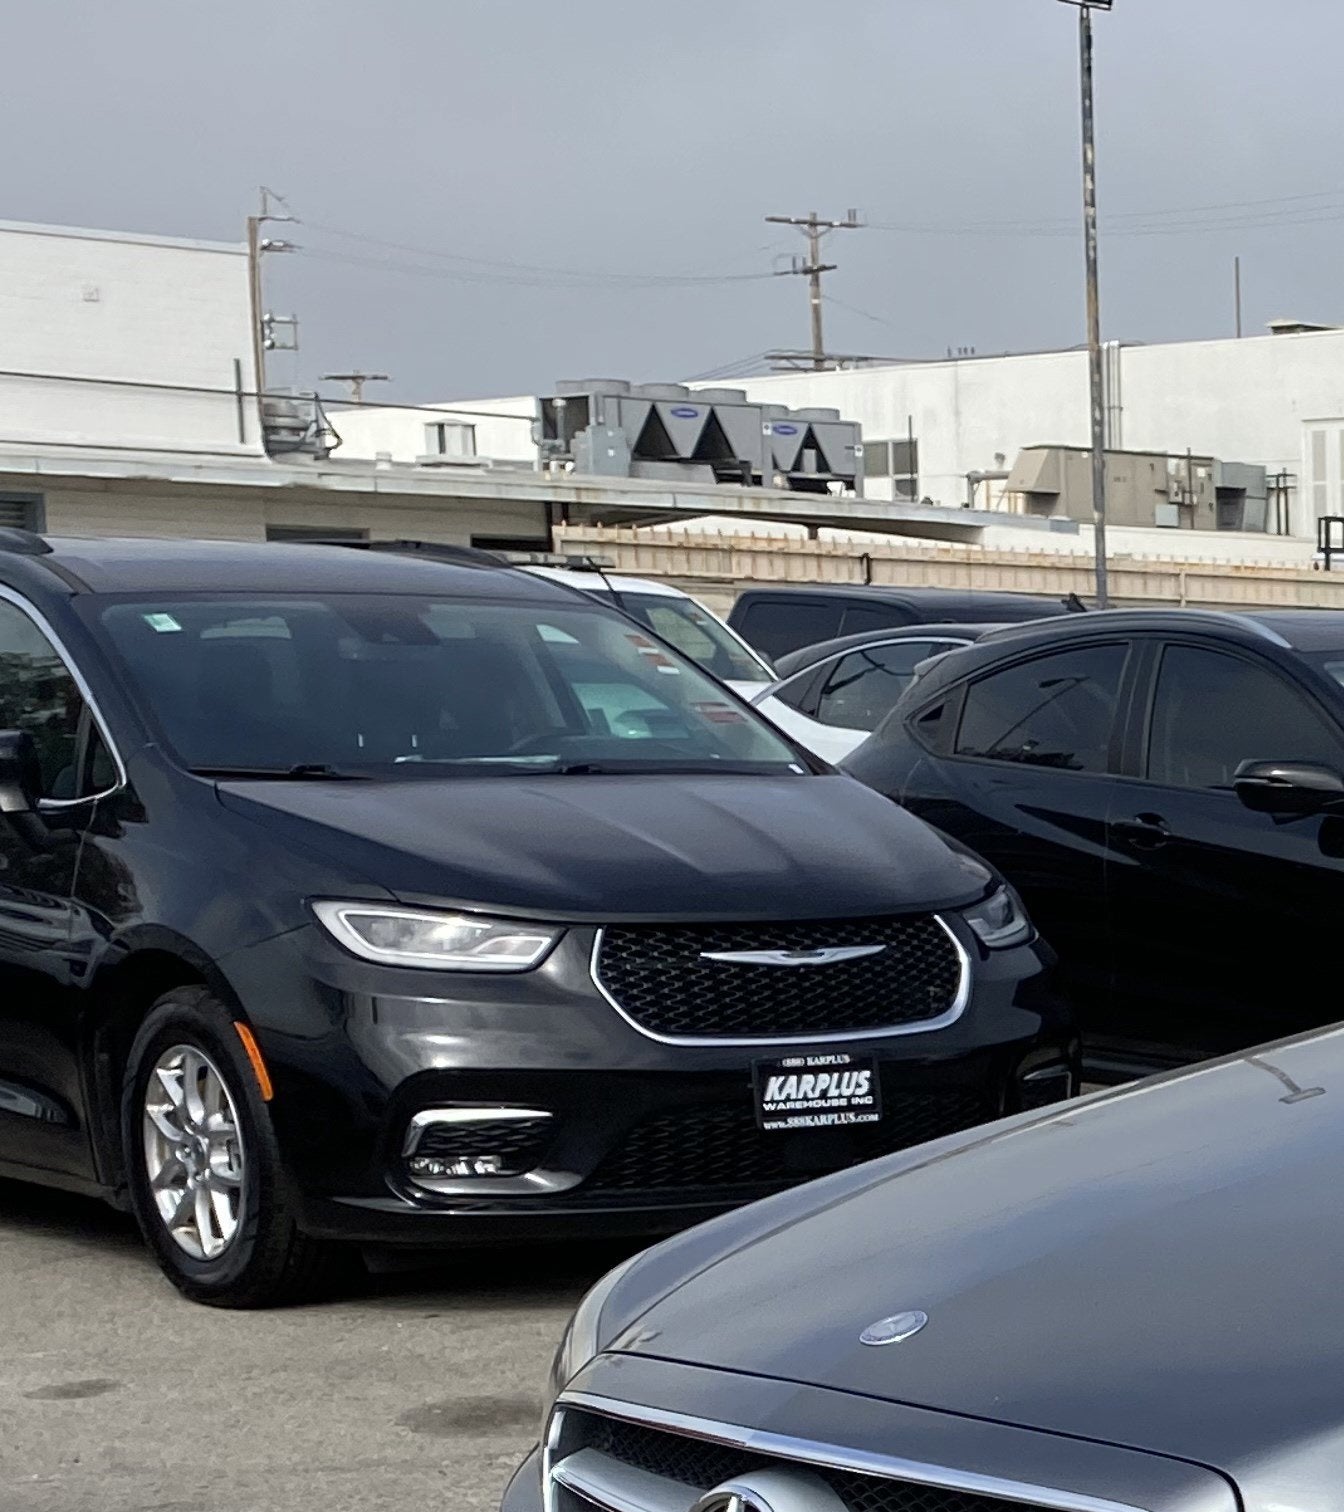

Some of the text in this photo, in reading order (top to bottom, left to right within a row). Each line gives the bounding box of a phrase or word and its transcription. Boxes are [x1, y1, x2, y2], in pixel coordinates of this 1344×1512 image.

[807, 1054, 850, 1066] KARPLUS
[764, 1070, 871, 1101] KARPLUS
[763, 1096, 873, 1111] WAREHOUSE INC
